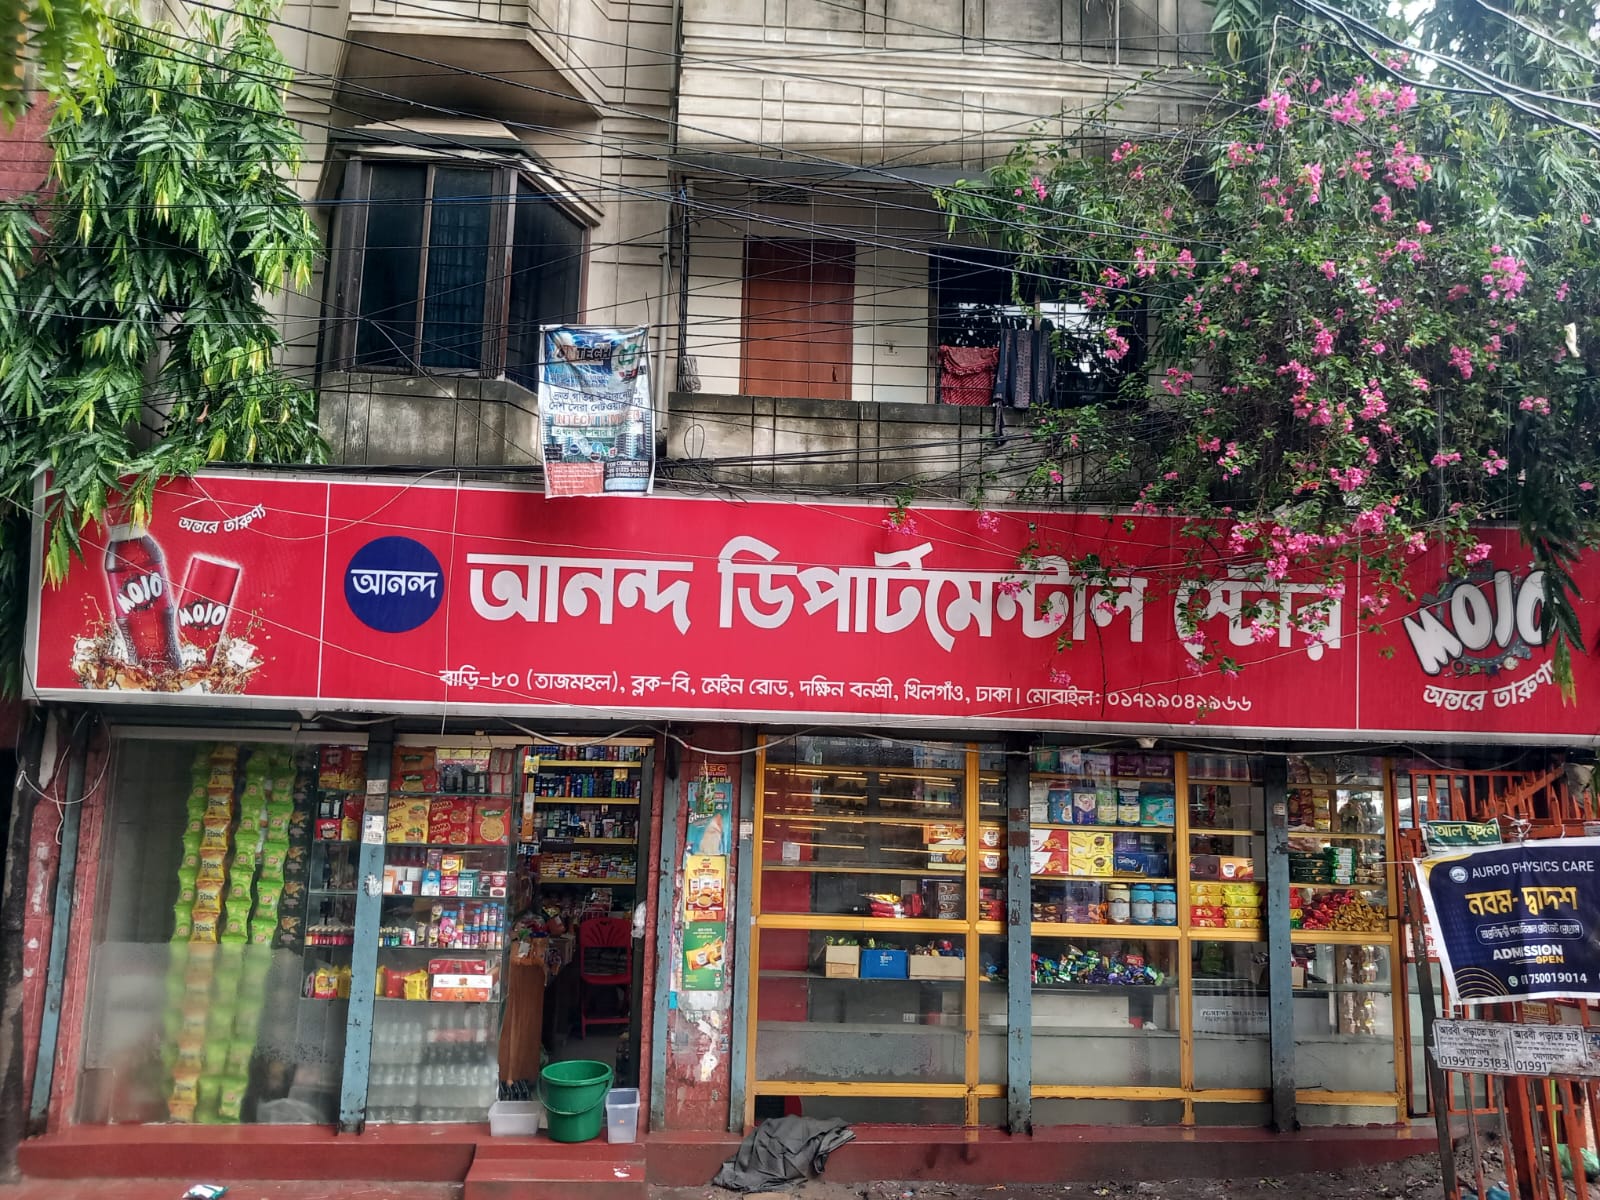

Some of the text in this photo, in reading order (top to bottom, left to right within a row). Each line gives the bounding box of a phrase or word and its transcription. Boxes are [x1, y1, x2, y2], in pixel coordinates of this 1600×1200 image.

[178, 503, 267, 535] অন্তরে তারুণ্য
[117, 572, 163, 614] MOJO
[350, 568, 439, 599] আনন্দ
[466, 535, 1346, 664] আনন্দ ডিপার্টমেন্টাল স্টোর
[178, 602, 228, 627] MOJO
[439, 664, 521, 691] বাড়ি-৮০
[526, 668, 626, 694] (তাজমহল),
[630, 671, 696, 697] ব্লক-বি,
[701, 674, 745, 695] মেইন
[749, 679, 795, 699] রোড,
[799, 674, 845, 698] দক্ষিন
[849, 677, 899, 702] বনশ্রী,
[904, 678, 971, 704] খিলগাঁও,
[1422, 683, 1488, 711] অন্তরে
[1472, 863, 1510, 879] AURPO
[1511, 860, 1560, 874] PHYSICS
[1562, 860, 1595, 872] CARE
[1521, 886, 1578, 916] দ্বাদশ
[1492, 944, 1564, 961] ADMISSION
[1535, 955, 1565, 965] OPEN
[1566, 1030, 1582, 1043] চাই
[1515, 1060, 1552, 1072] 01991
